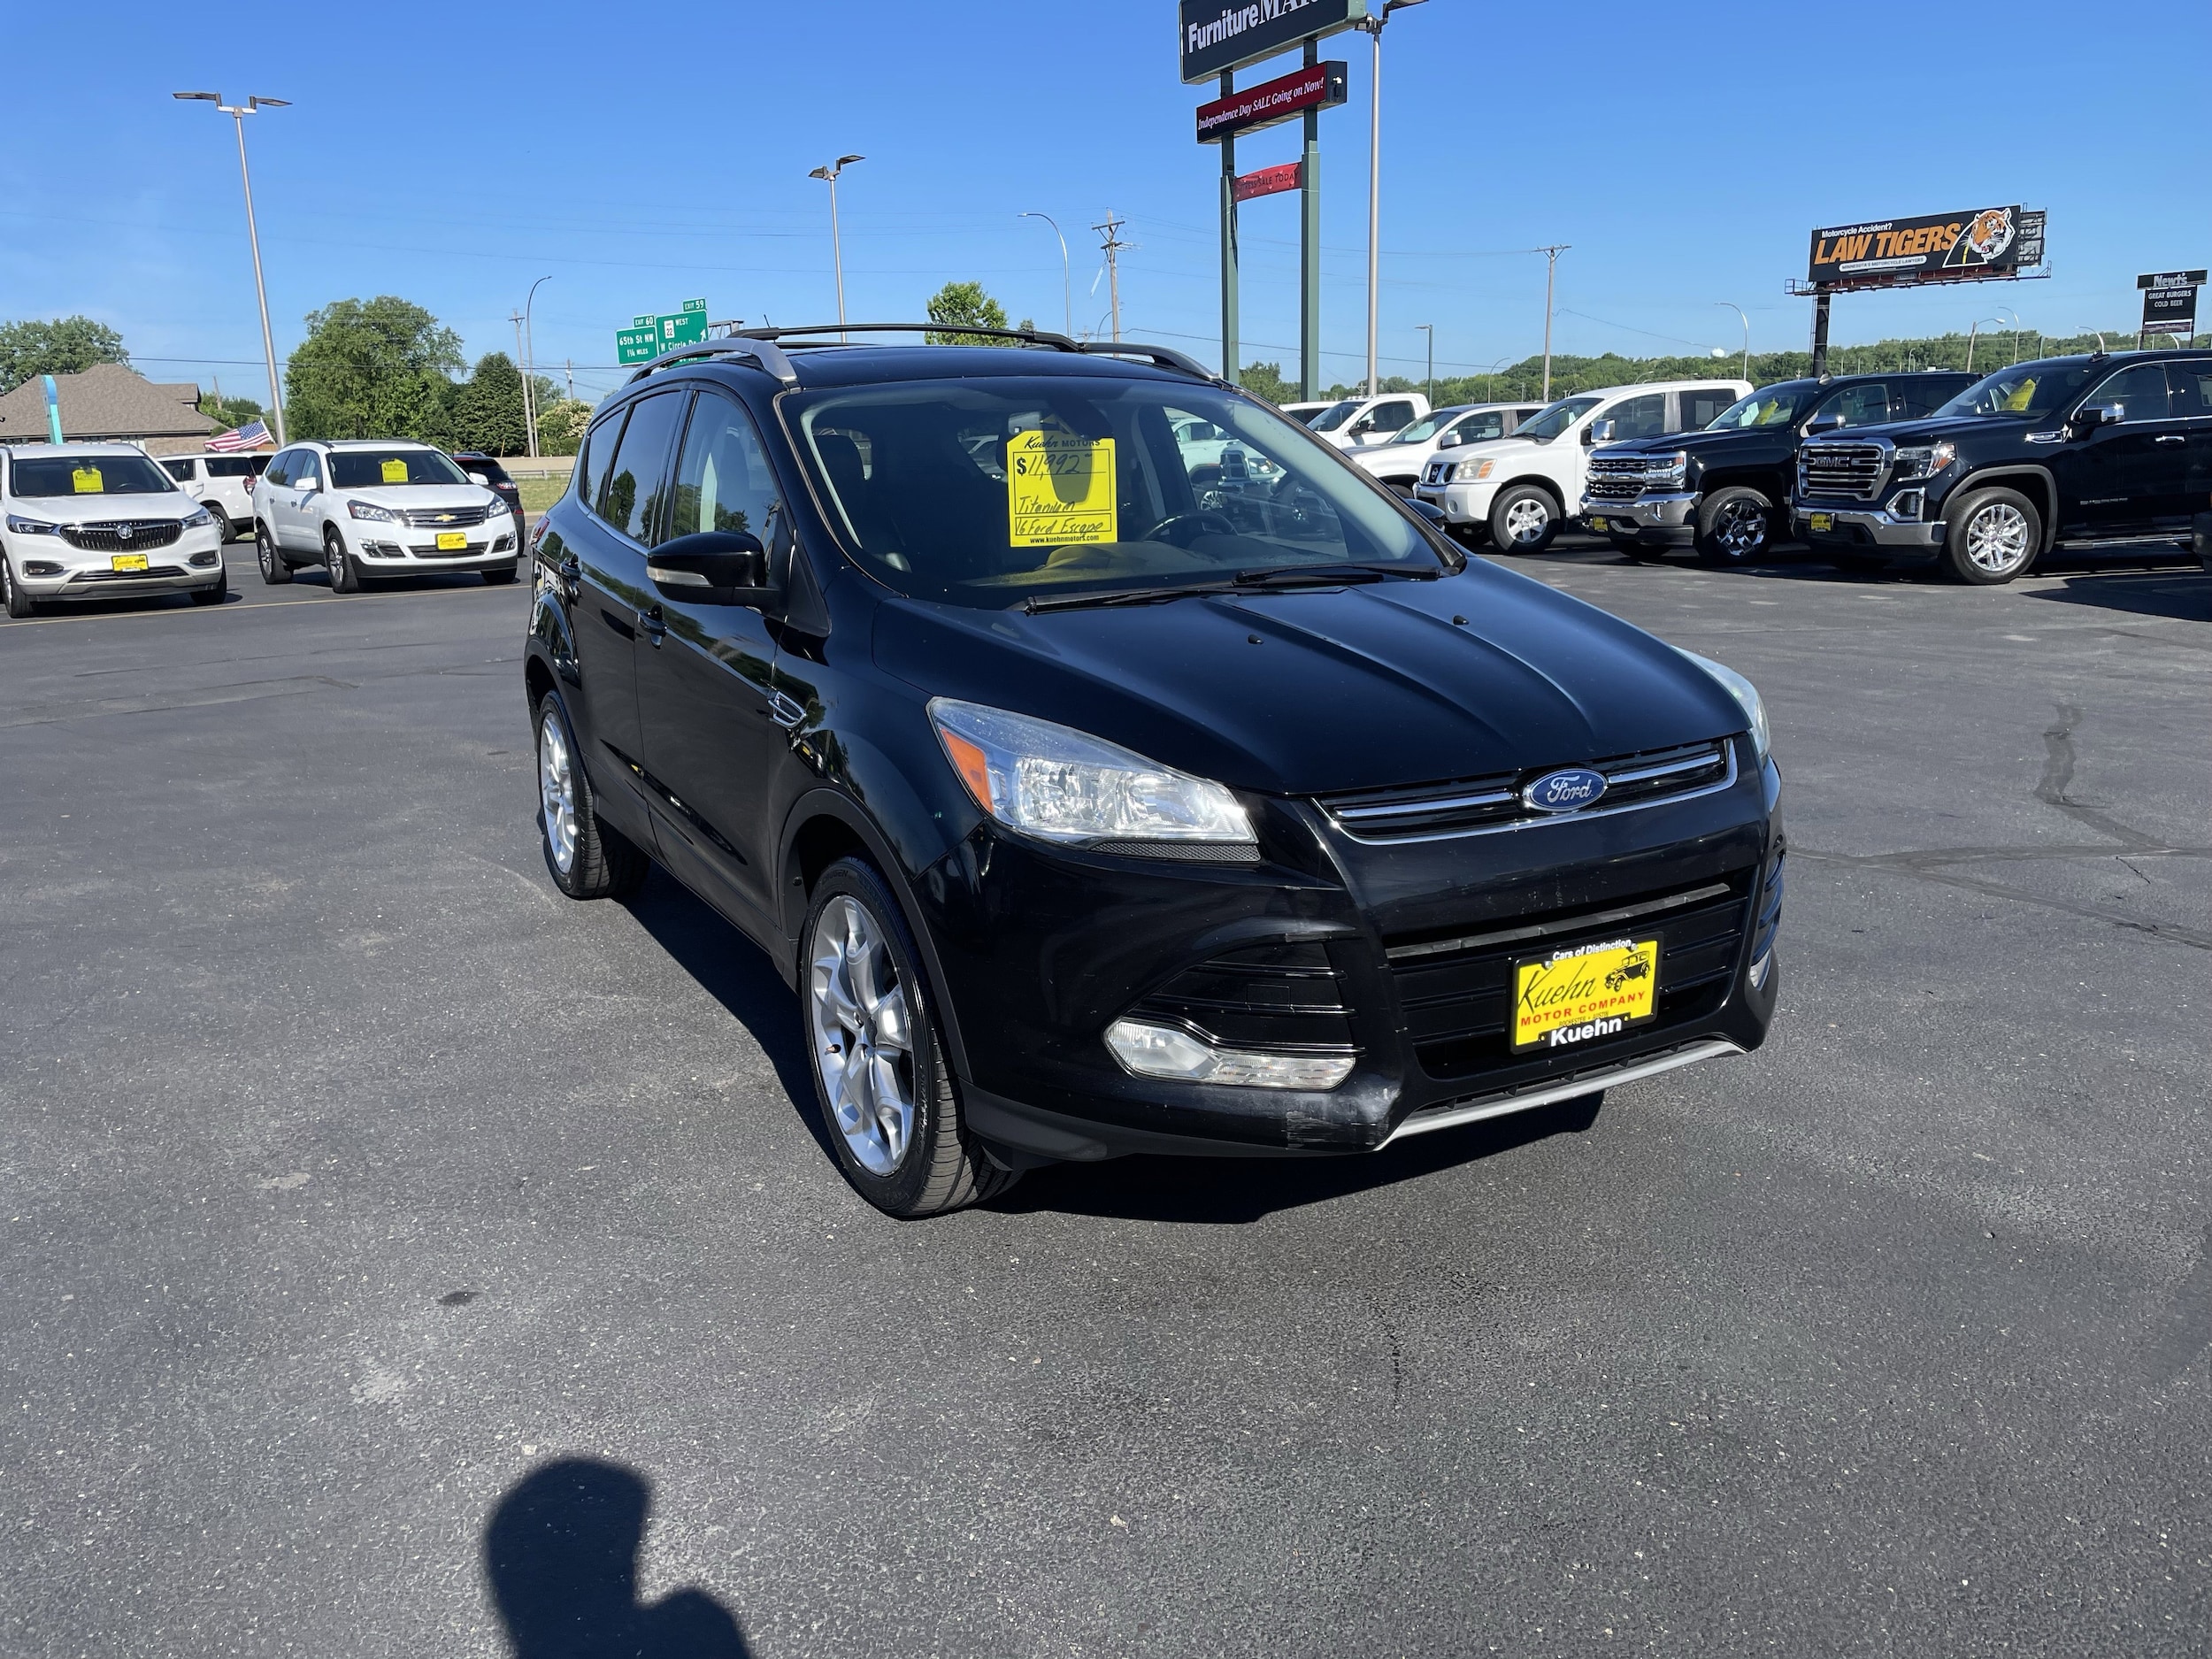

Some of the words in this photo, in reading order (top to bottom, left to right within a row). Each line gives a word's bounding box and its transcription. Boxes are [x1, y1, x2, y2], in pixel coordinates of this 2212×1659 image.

[1198, 108, 1238, 130] Independence
[1239, 104, 1252, 117] Day
[1253, 96, 1271, 111] SALE
[1271, 89, 1293, 104] Going
[1294, 88, 1303, 97] on
[1303, 77, 1325, 95] Now!
[1258, 177, 1272, 187] SALE
[1822, 227, 1858, 238] Motorcycle
[1858, 223, 1893, 234] Accident?
[1814, 234, 1873, 265] LAW
[1876, 222, 1962, 257] TIGERS
[2153, 273, 2188, 288] Newt's
[695, 300, 704, 309] 59
[675, 318, 688, 326] WEST
[619, 336, 634, 346] 65th
[635, 334, 643, 344] St
[644, 334, 654, 343] NW
[660, 342, 666, 352] W
[668, 341, 687, 351] Circle
[1024, 435, 1058, 449] Kuehn
[1816, 457, 1849, 467] GMC
[1018, 495, 1075, 514] Titanium
[1028, 518, 1057, 535] Ford
[1060, 518, 1103, 537] Escape
[1030, 534, 1099, 543] www.kuehnmotors.com
[1547, 775, 1592, 803] Ford
[1553, 949, 1574, 962] Cars
[1575, 946, 1586, 957] of
[1586, 938, 1632, 955] Distinction
[1517, 961, 1596, 1014] Kuehn
[1520, 1008, 1572, 1026] MOTOR
[1578, 991, 1646, 1014] COMPANY
[1550, 1018, 1622, 1047] Kuehn
